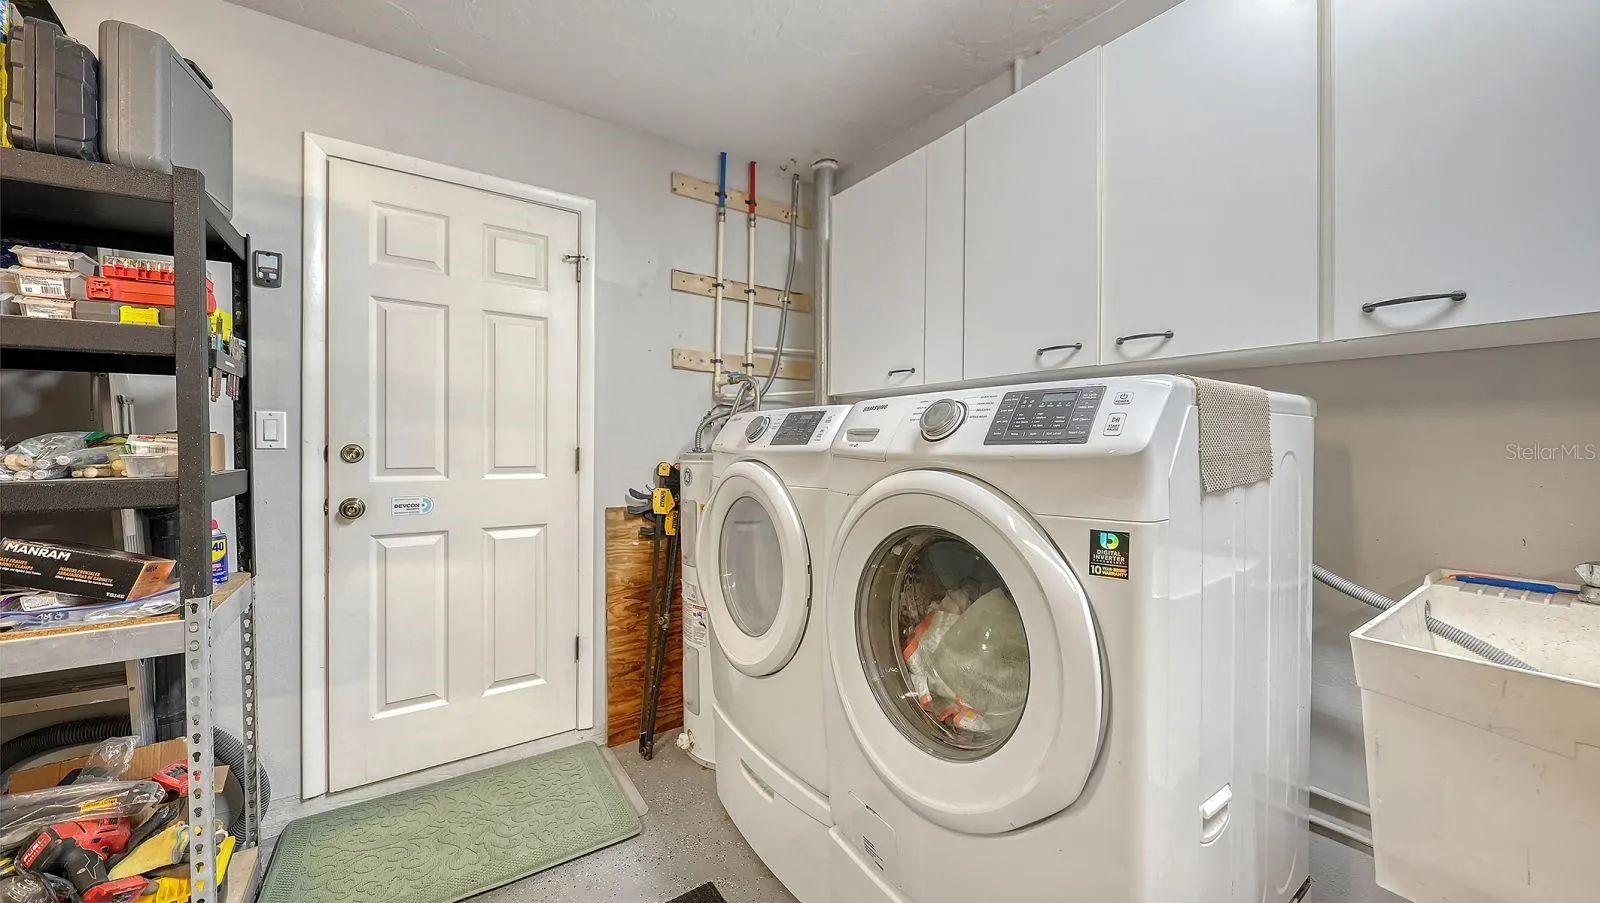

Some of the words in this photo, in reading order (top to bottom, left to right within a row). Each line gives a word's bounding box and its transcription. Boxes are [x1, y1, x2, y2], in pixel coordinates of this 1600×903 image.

[862, 404, 889, 412] SAMSUNG
[4, 543, 72, 561] MANRAM
[1093, 554, 1125, 562] INVERTER
[1090, 565, 1102, 575] 10
